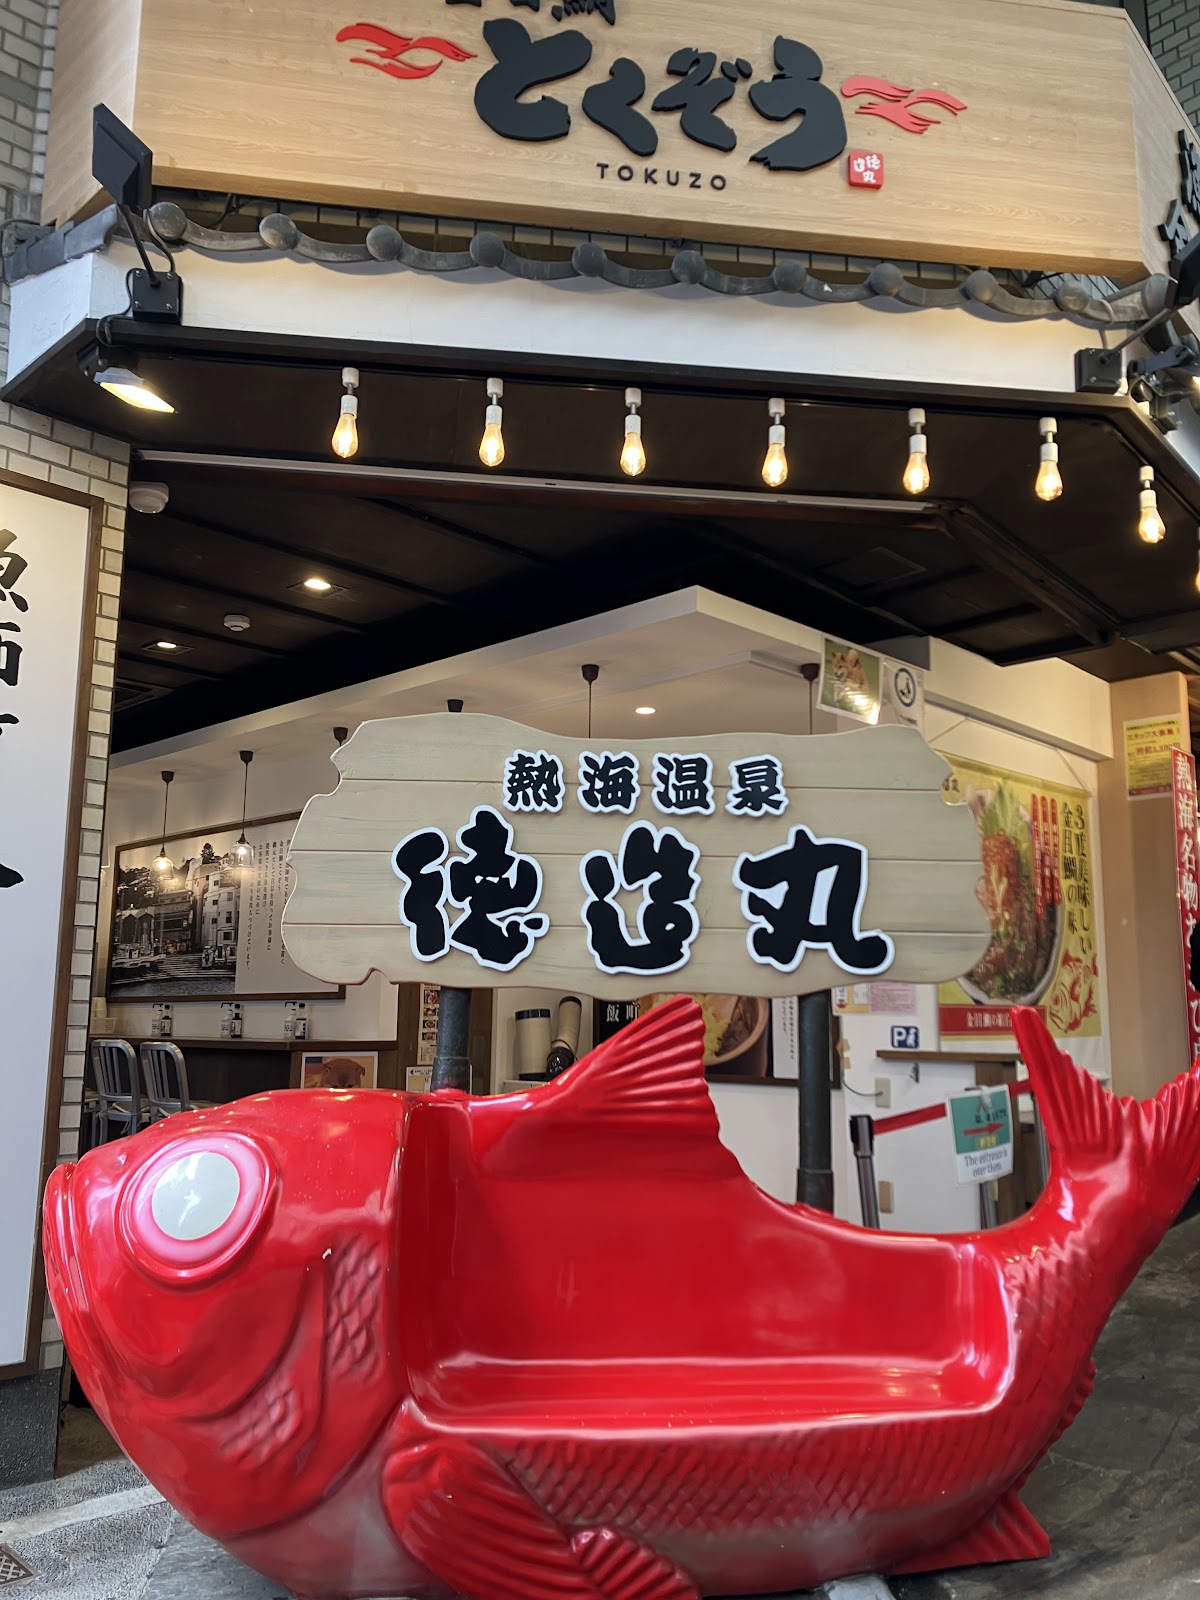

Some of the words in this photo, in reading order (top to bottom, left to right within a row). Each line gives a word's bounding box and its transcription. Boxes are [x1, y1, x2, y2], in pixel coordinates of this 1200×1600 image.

[473, 17, 848, 171] とくぞう
[596, 162, 727, 191] TOKUZO
[503, 749, 789, 818] 熱海温泉
[964, 1154, 979, 1167] The
